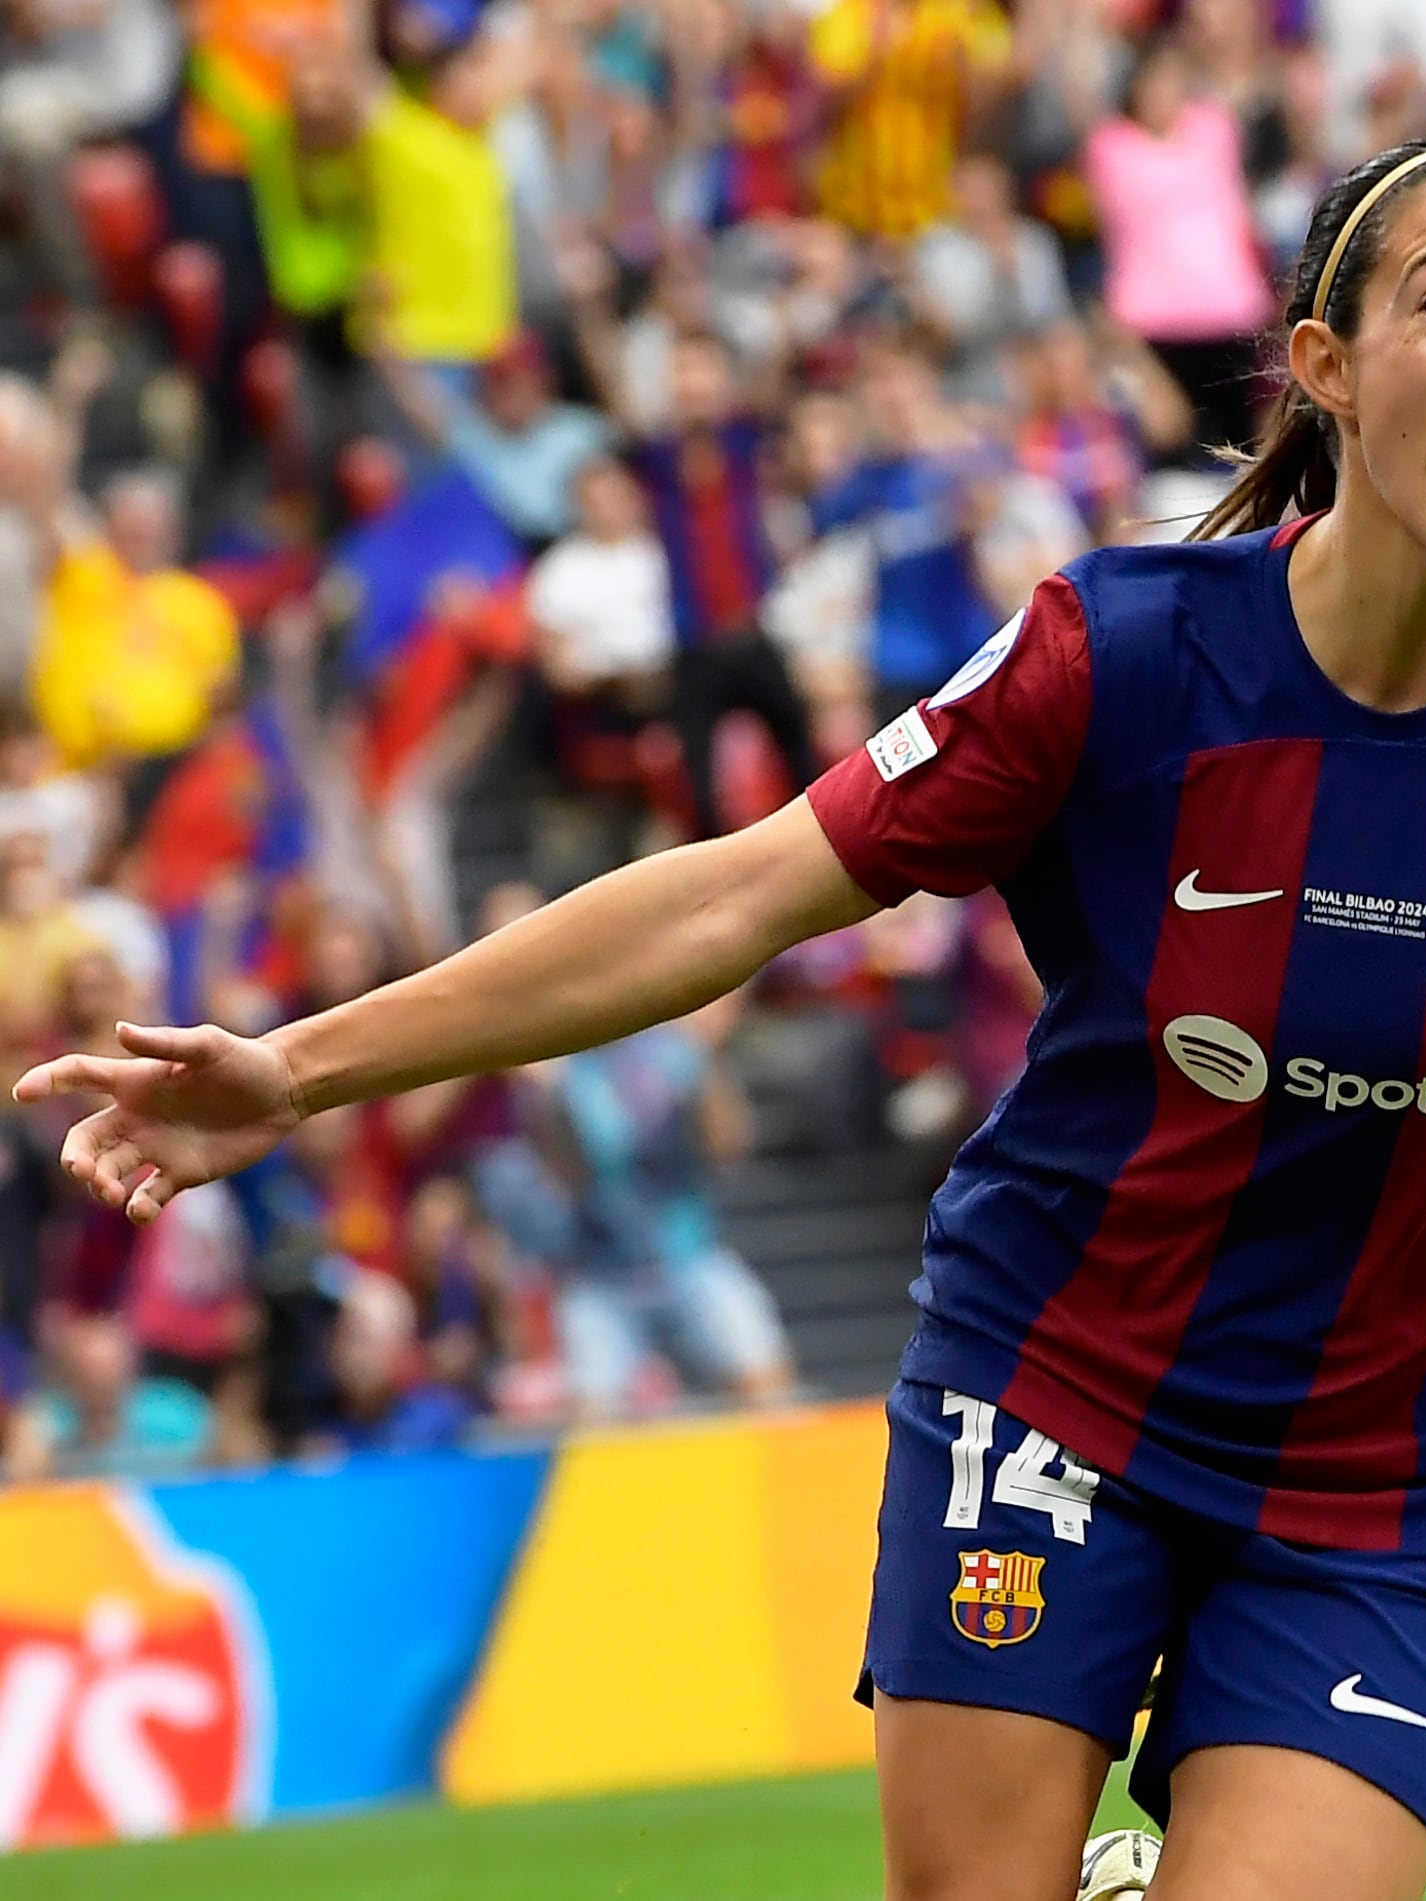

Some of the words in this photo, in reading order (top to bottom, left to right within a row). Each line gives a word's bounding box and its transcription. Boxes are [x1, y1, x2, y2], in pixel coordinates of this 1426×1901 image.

[1303, 887, 1343, 906] FINAL
[1345, 893, 1396, 913] BILBAO
[1312, 915, 1351, 928] BARCELONA
[1355, 910, 1390, 924] STADIUM
[942, 1387, 1101, 1546] 14
[979, 1589, 1015, 1603] FCB
